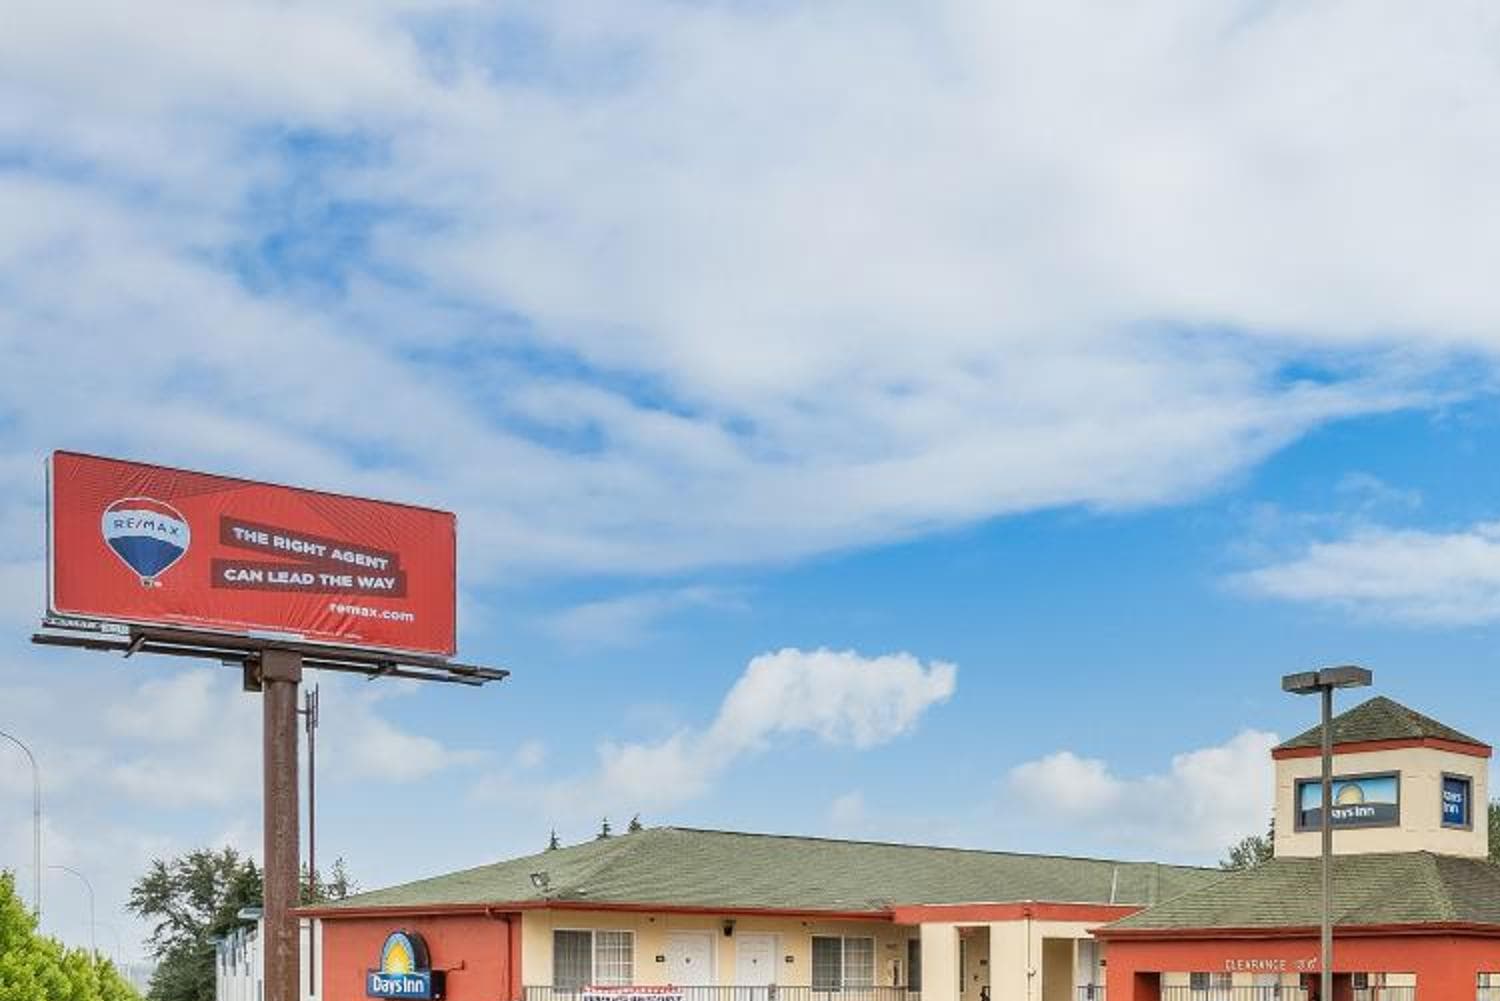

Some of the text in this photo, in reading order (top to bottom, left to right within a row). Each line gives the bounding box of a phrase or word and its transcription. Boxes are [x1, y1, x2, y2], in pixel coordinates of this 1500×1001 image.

[113, 517, 180, 536] RE/MAX
[232, 526, 389, 571] THE RIGHT AGENT
[223, 568, 396, 590] CAN LEAD THE WAY
[329, 602, 415, 622] remax.com
[1331, 808, 1353, 819] ays
[1225, 959, 1287, 971] CLEARANCE
[373, 975, 425, 995] Days Inn
